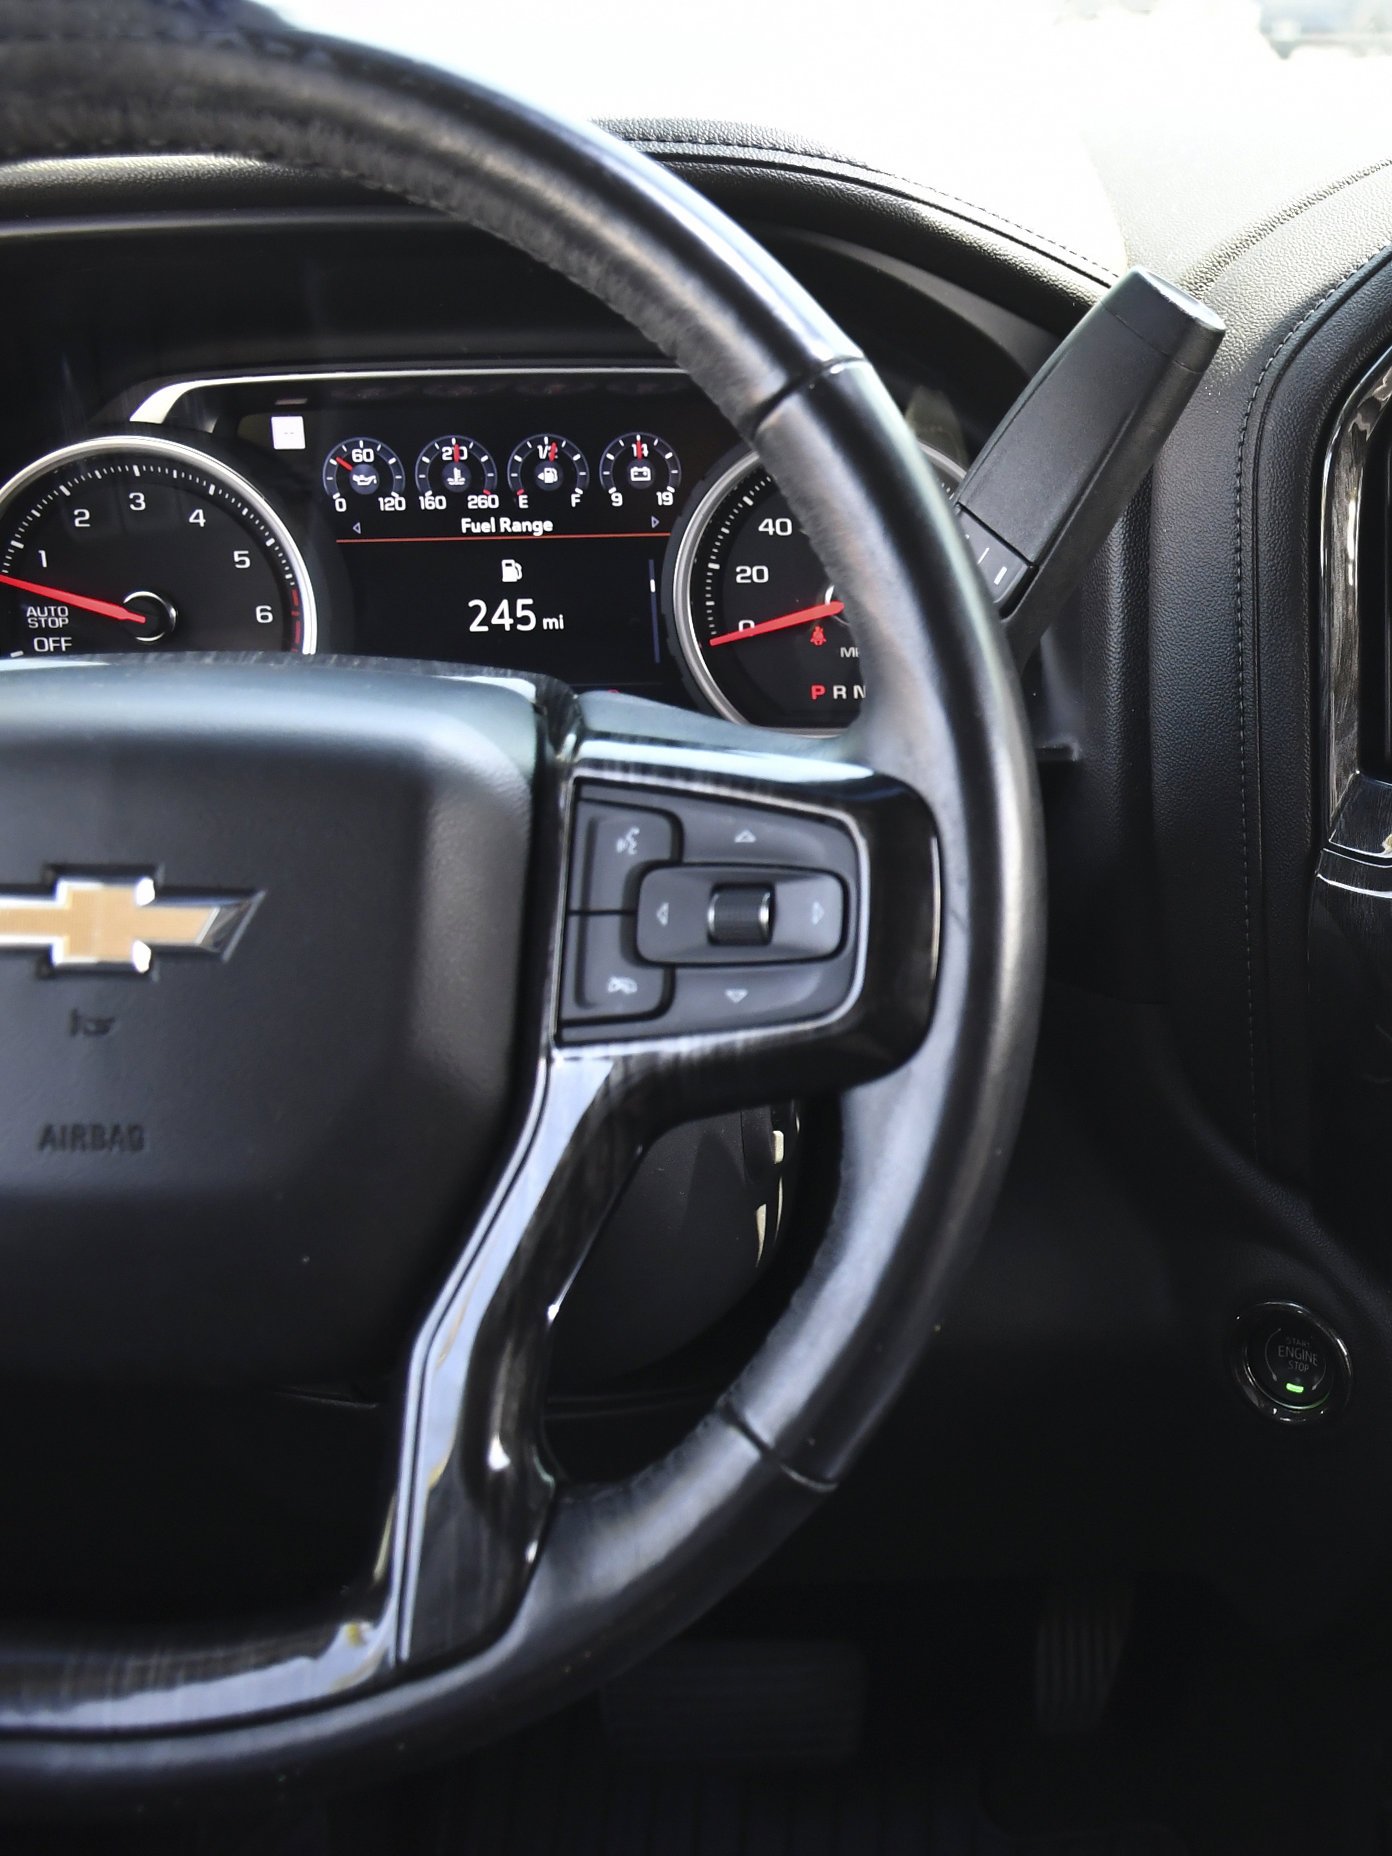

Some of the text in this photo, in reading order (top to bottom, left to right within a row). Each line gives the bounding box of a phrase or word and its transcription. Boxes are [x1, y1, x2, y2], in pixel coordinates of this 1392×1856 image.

[351, 449, 375, 463] 60
[129, 492, 146, 511] 3
[335, 497, 347, 512] 0
[379, 497, 407, 512] 120
[419, 495, 447, 510] 160
[467, 495, 499, 510] 260
[518, 494, 529, 510] E
[571, 493, 581, 508] F
[611, 492, 623, 507] 9
[656, 492, 674, 507] 19
[74, 509, 91, 527] 2
[188, 509, 206, 527] 4
[461, 517, 554, 537] Fuel Range
[758, 517, 793, 536] 40
[38, 550, 48, 568] 1
[233, 551, 251, 568] 5
[735, 565, 769, 584] 20
[26, 605, 69, 618] AUTO
[255, 605, 273, 623] 6
[468, 599, 565, 632] 245 mi
[28, 617, 70, 629] STOP
[33, 637, 72, 652] OFF
[811, 684, 826, 700] P
[833, 684, 847, 699] R
[1278, 1345, 1318, 1366] ENGINE
[1288, 1361, 1309, 1372] STOP
